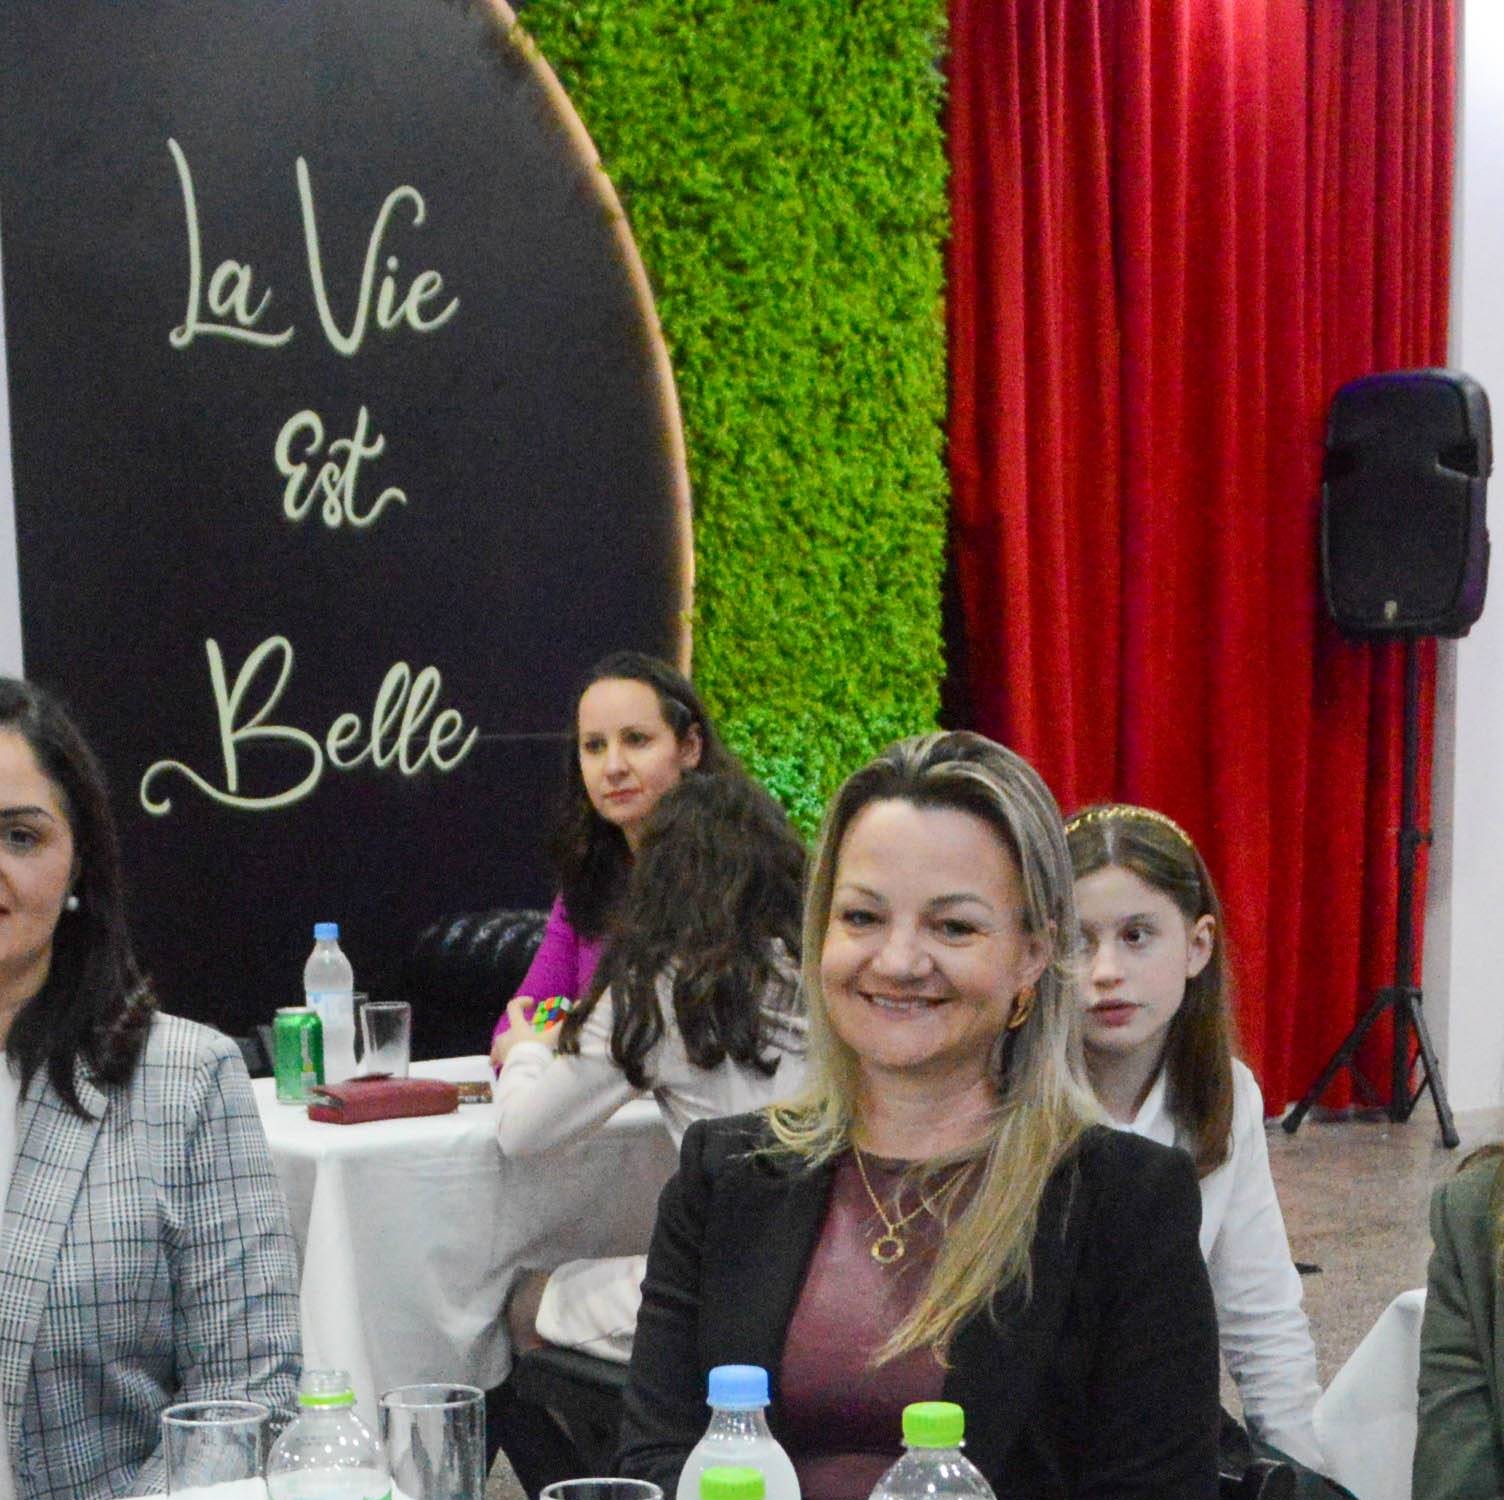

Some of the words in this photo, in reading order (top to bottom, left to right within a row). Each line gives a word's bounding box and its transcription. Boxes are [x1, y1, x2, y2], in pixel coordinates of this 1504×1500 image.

[168, 138, 294, 348] La
[296, 156, 459, 355] Vie
[275, 405, 407, 528] Est
[140, 635, 479, 815] Belle
